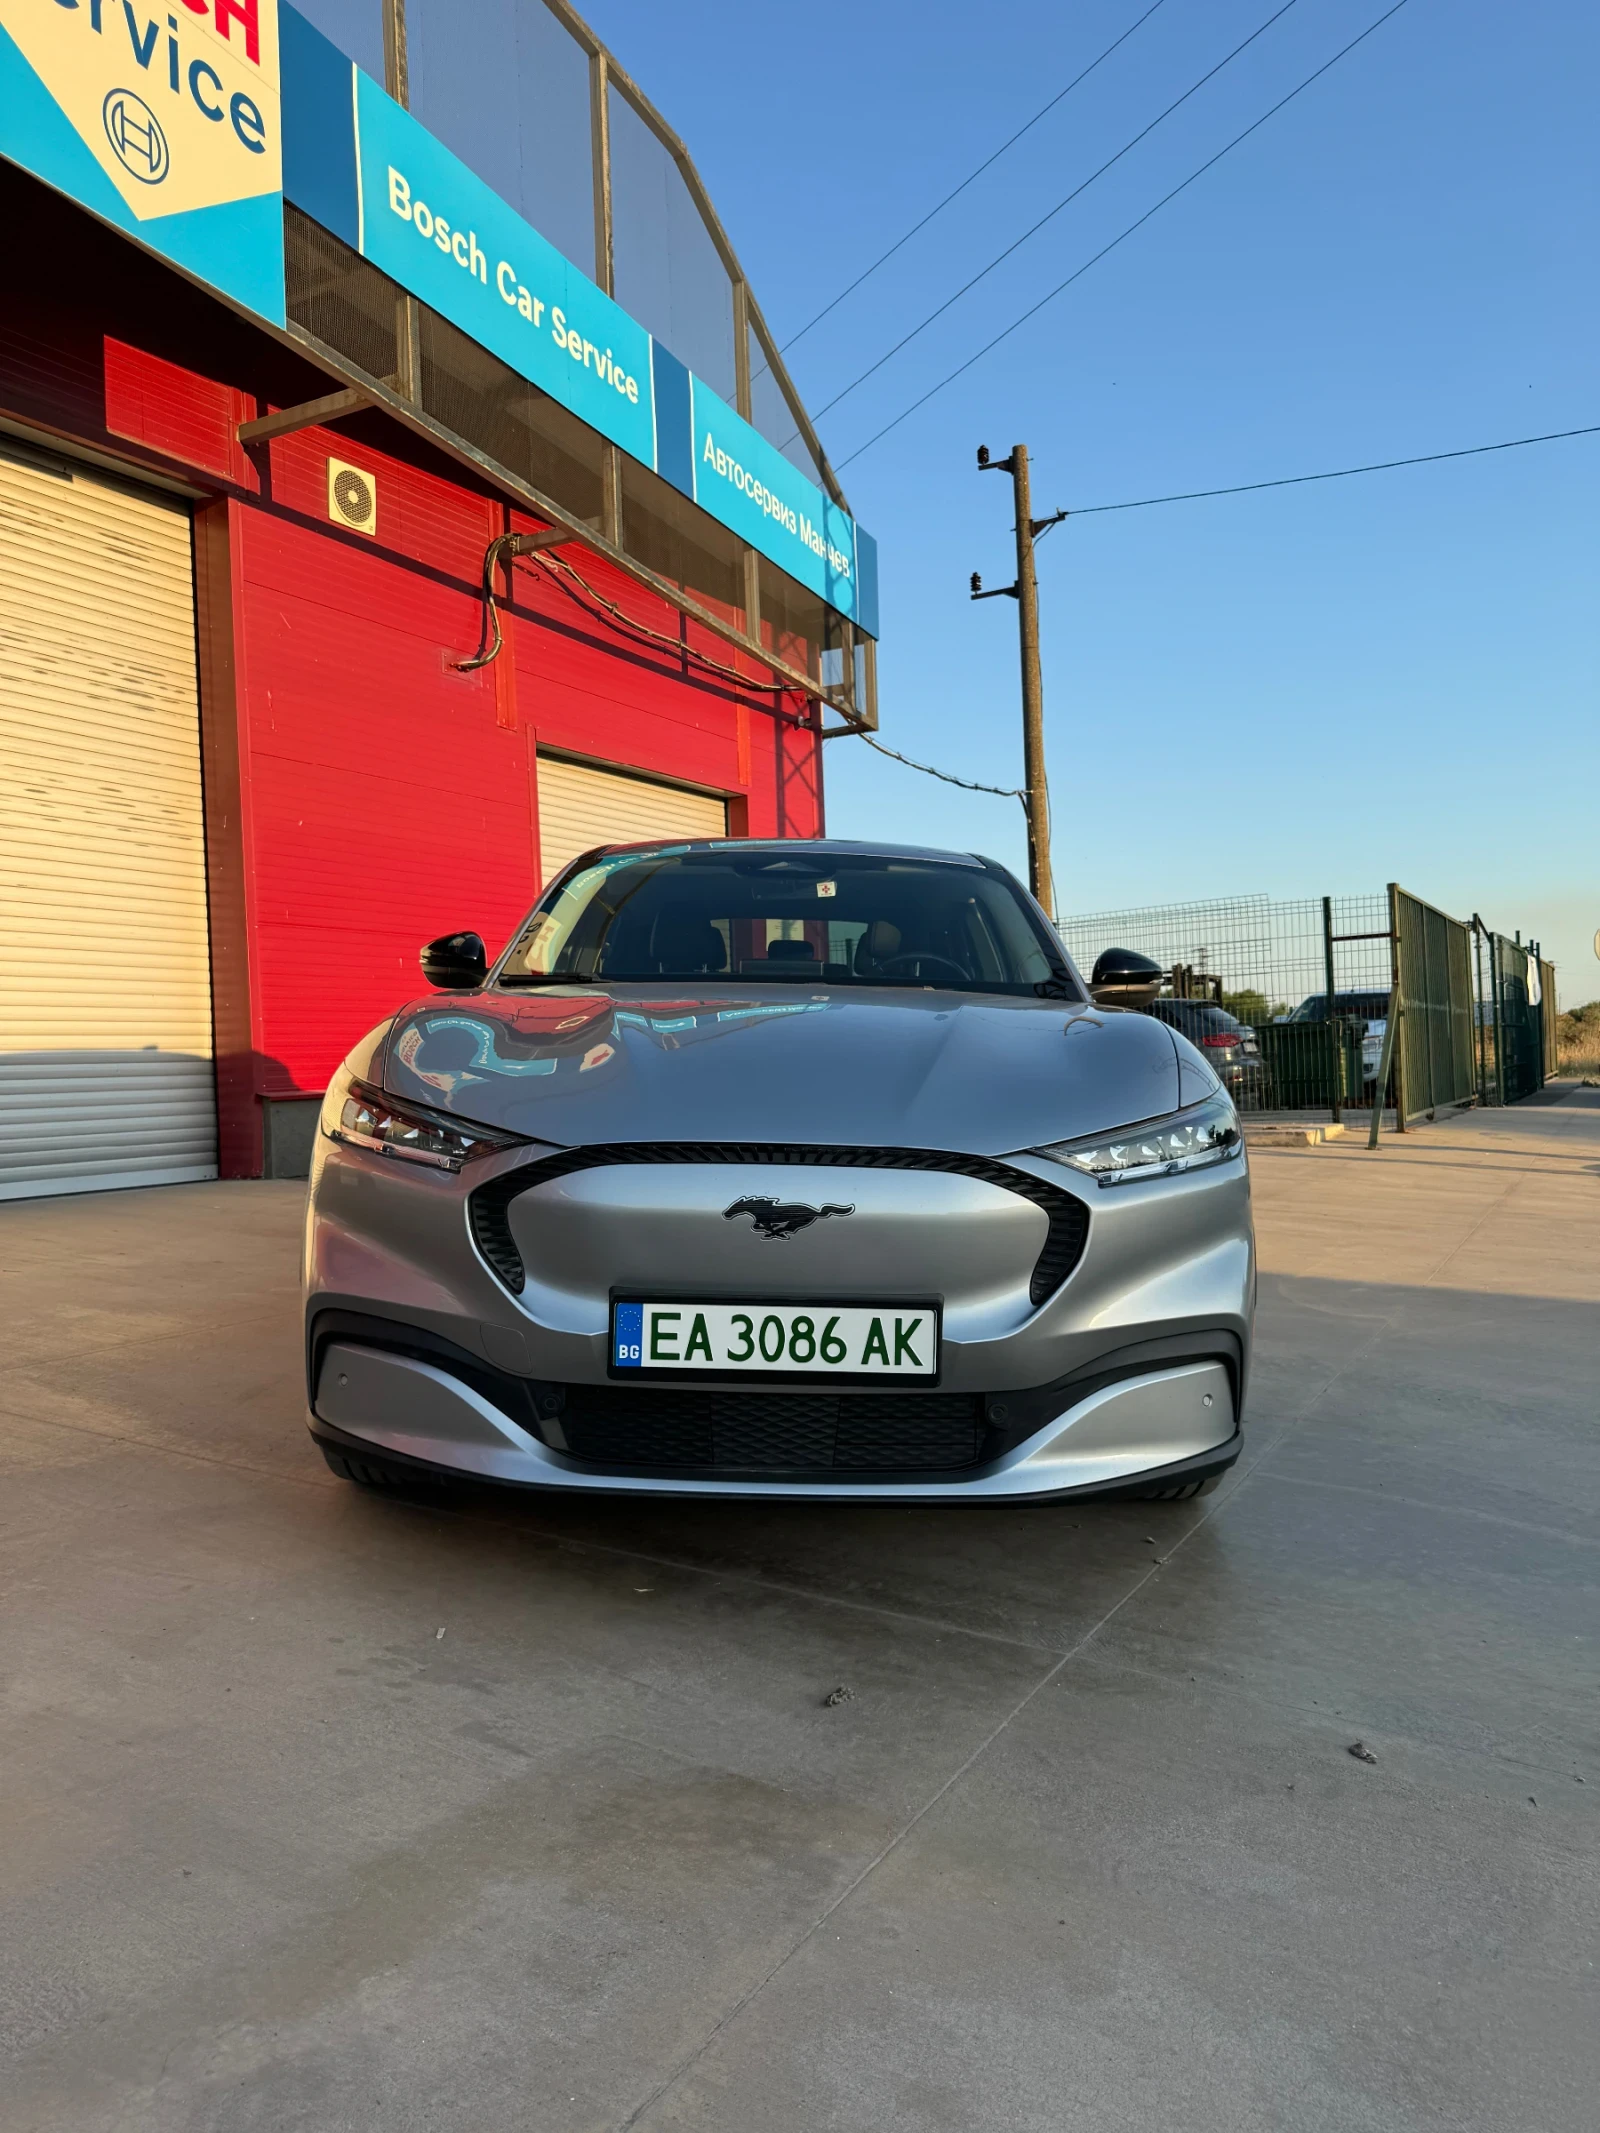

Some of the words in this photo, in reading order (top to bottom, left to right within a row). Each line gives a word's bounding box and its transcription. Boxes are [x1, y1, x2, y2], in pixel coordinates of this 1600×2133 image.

[54, 0, 266, 154] vice
[387, 165, 488, 285] Bosch
[496, 260, 545, 328] Car
[551, 306, 639, 404] Service
[703, 432, 797, 535] Автосервиз
[799, 512, 851, 578] Манчев
[618, 1344, 640, 1359] BG
[650, 1312, 714, 1361] EA
[727, 1313, 848, 1365] 3086
[860, 1317, 924, 1367] AK
